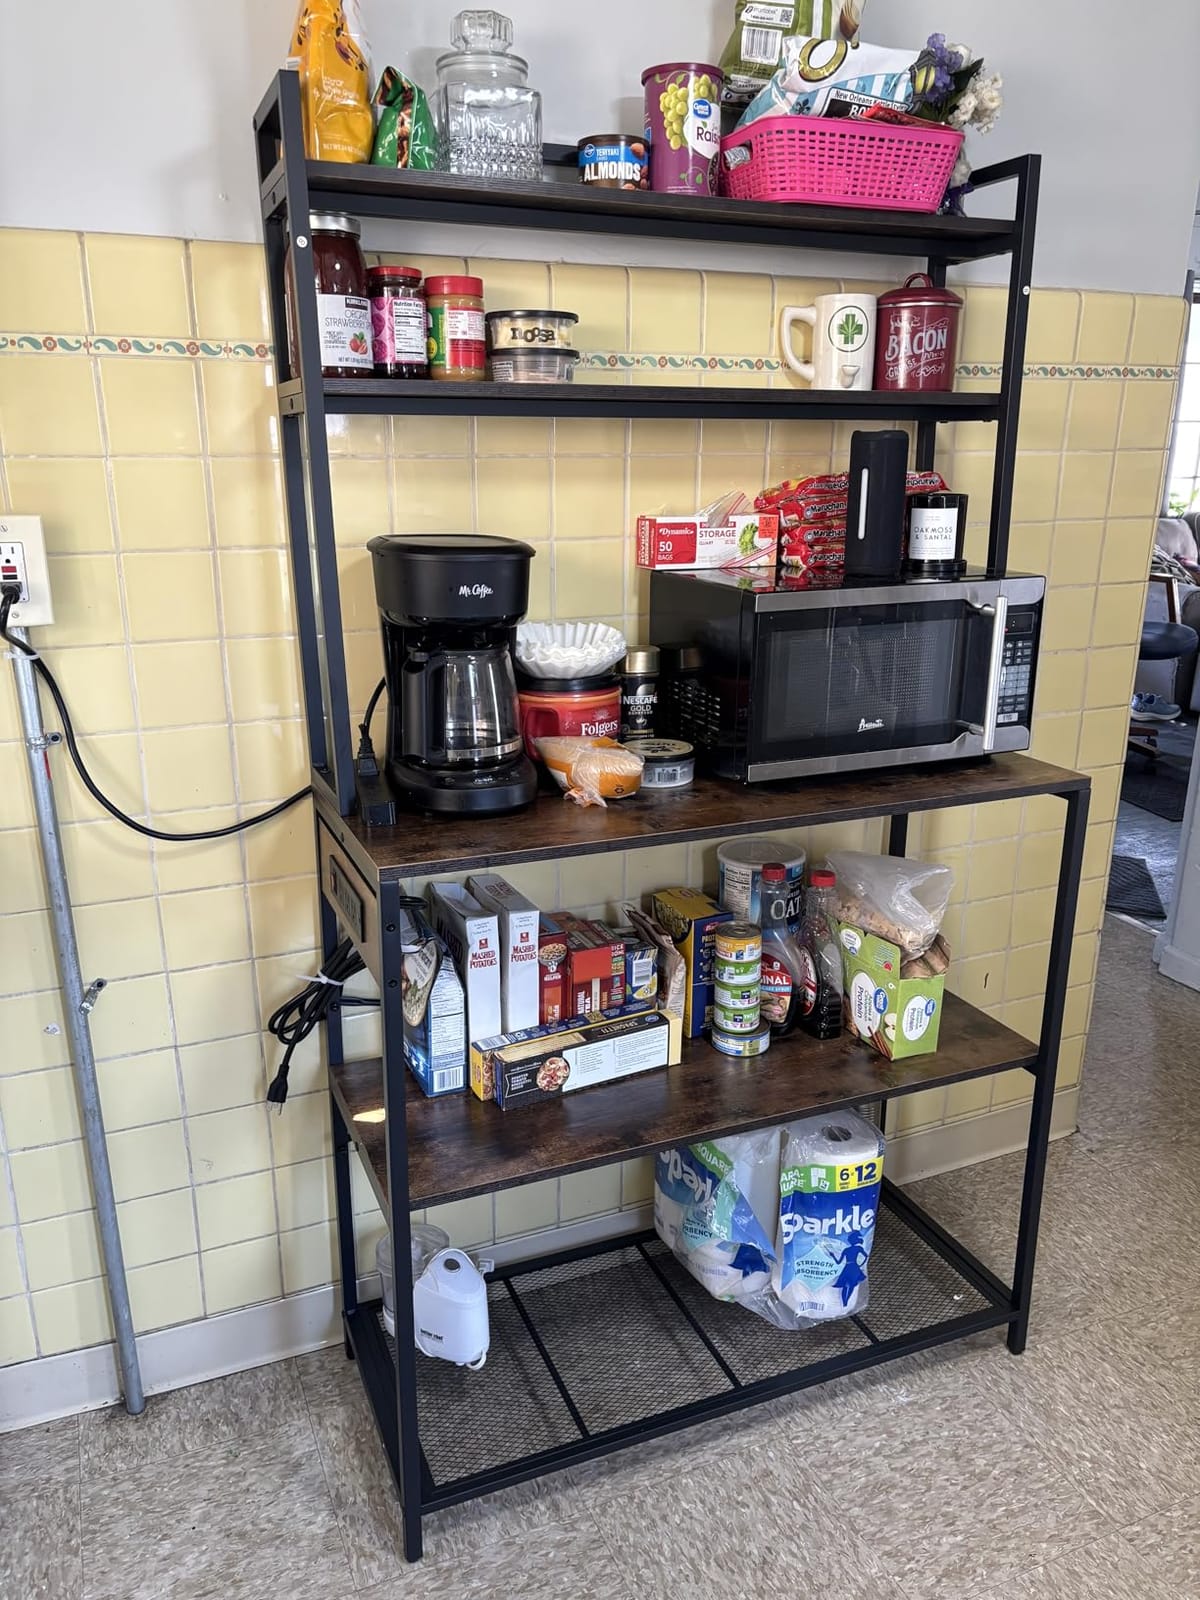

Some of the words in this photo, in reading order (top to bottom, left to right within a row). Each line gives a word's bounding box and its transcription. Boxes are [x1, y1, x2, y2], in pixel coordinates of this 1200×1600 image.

[835, 90, 848, 99] New
[849, 93, 873, 104] Orleans
[584, 161, 641, 182] ALMONDS
[510, 327, 555, 342] noosa
[885, 329, 948, 362] BACON
[659, 527, 694, 538] Dynamic
[699, 529, 737, 538] STORAGE
[659, 541, 673, 552] 50
[472, 584, 494, 599] Coffee
[581, 720, 618, 737] Folgers
[471, 950, 495, 960] MASHED
[512, 944, 535, 954] MASHED
[470, 959, 498, 969] POTATOES
[511, 952, 537, 963] POTATOES
[856, 985, 865, 1019] Protein
[840, 1168, 851, 1181] 6
[855, 1162, 877, 1182] 12
[780, 1205, 876, 1245] Sparkle
[796, 1260, 834, 1268] STRENGTH
